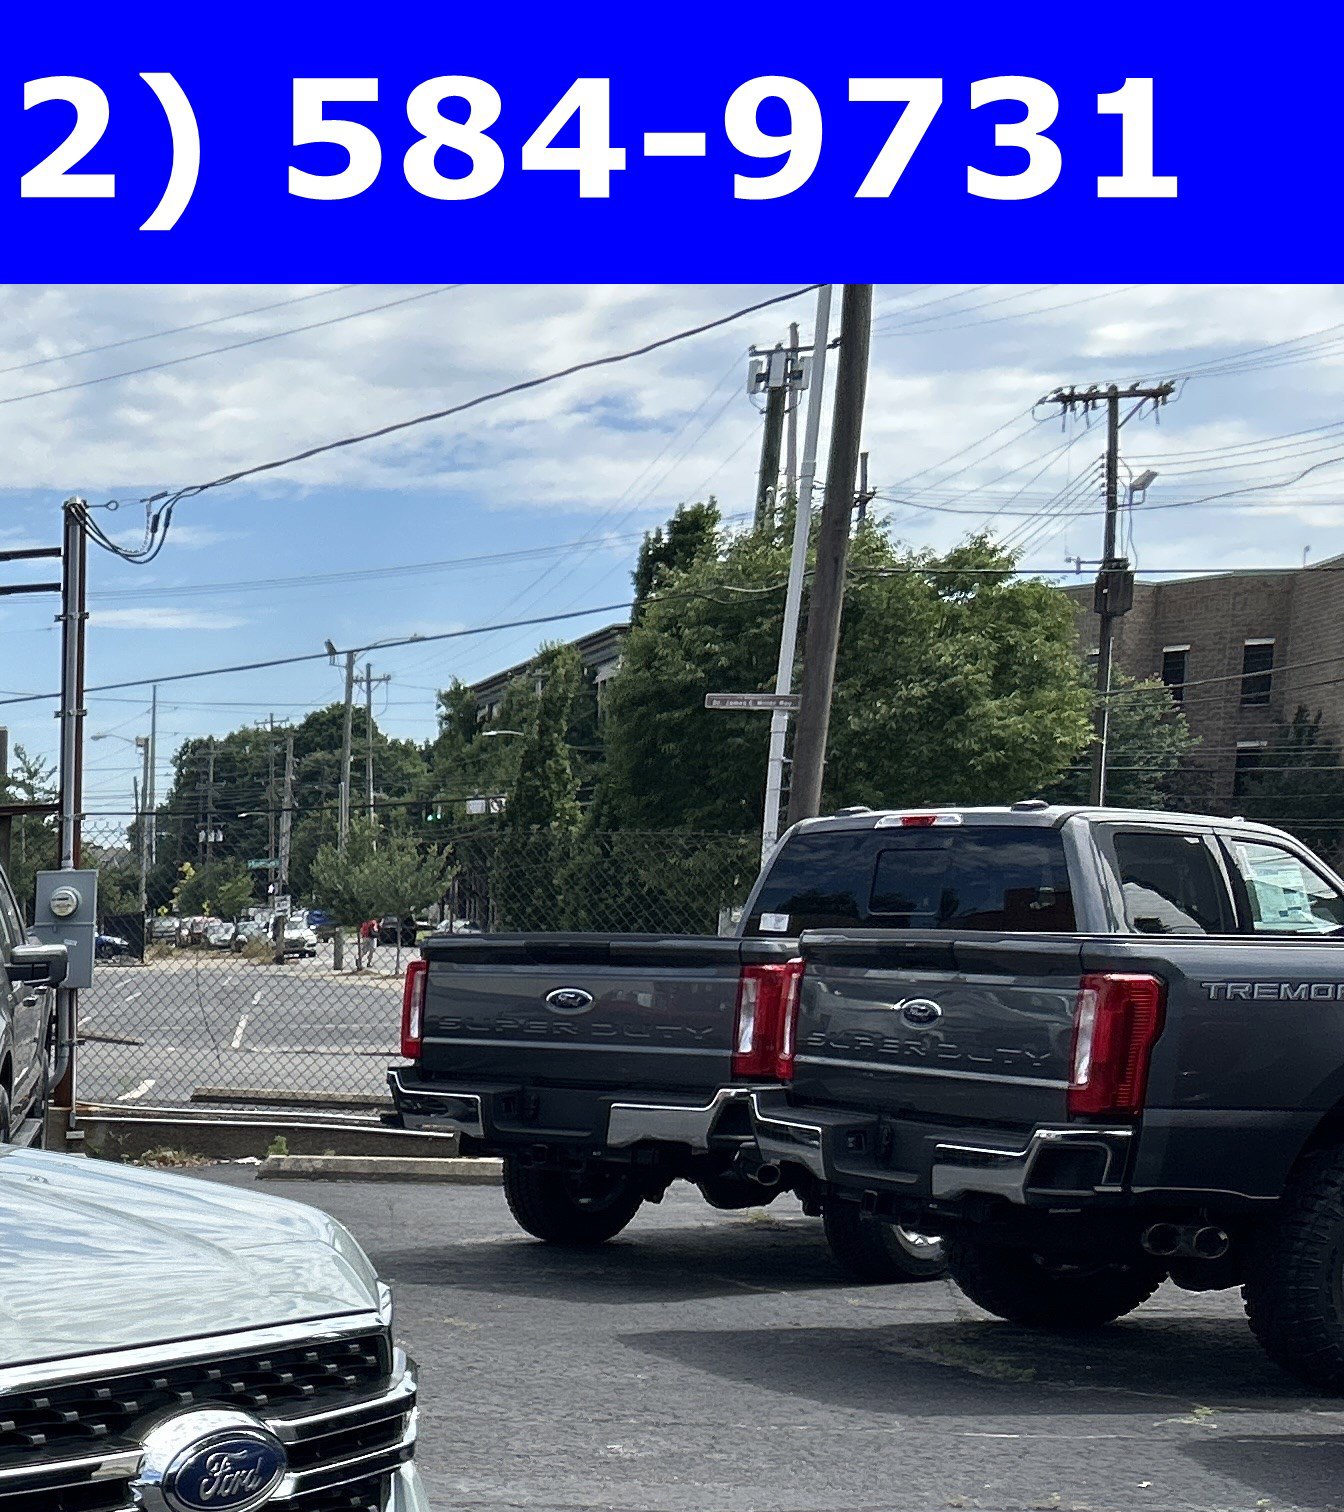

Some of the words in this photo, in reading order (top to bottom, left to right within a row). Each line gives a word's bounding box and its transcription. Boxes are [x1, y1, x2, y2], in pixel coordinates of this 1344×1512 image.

[439, 1016, 579, 1035] SUPER
[591, 1023, 713, 1040] DUTY
[807, 1032, 926, 1056] SUPER
[937, 1042, 1051, 1067] DUTY
[198, 1449, 263, 1502] Ford
